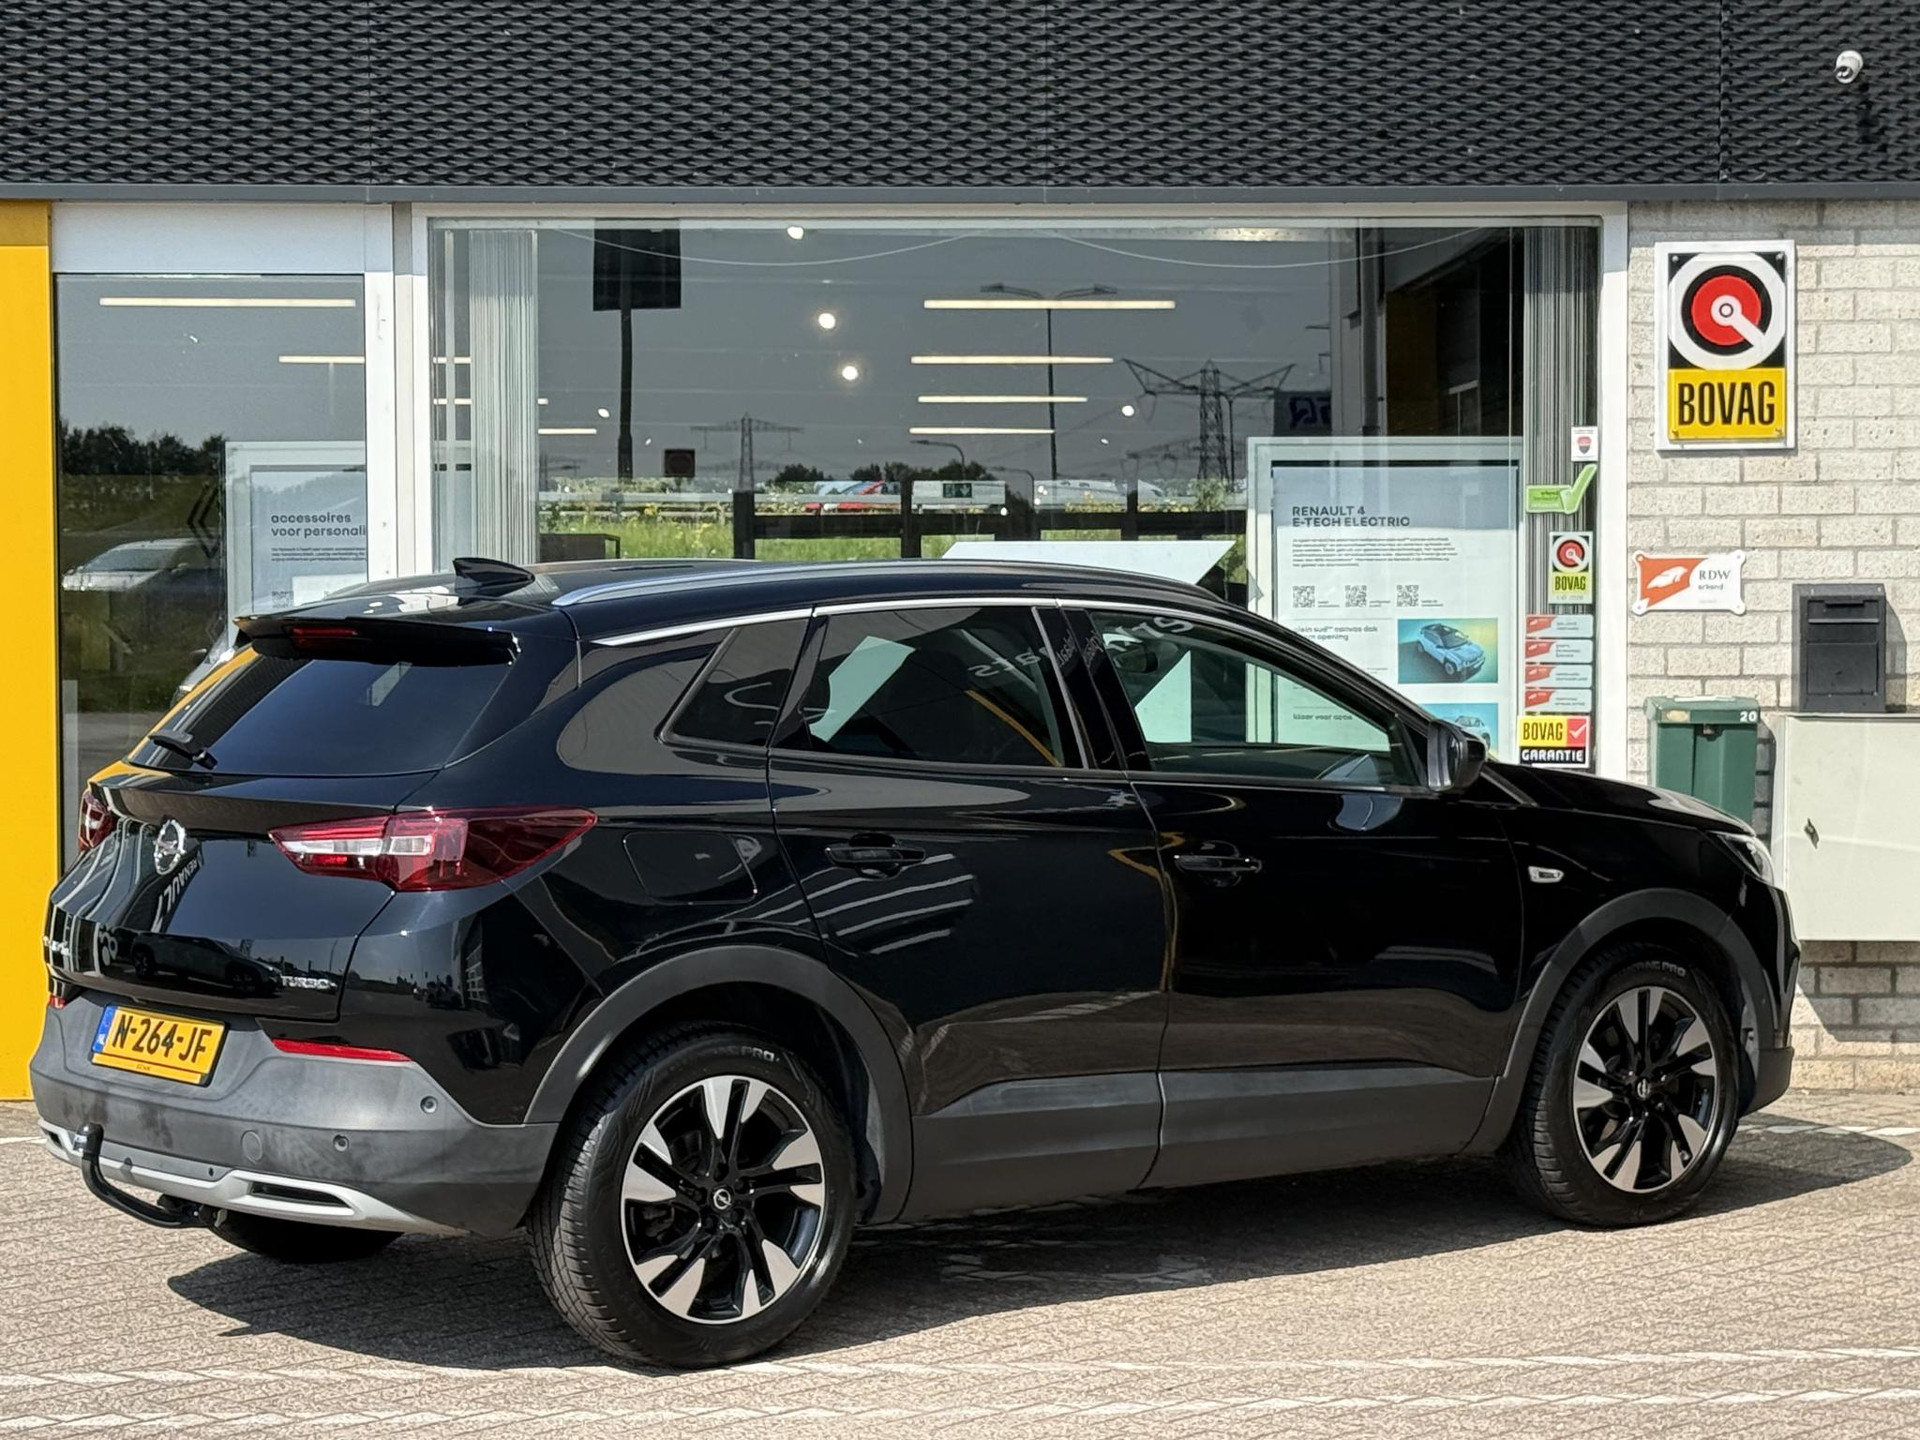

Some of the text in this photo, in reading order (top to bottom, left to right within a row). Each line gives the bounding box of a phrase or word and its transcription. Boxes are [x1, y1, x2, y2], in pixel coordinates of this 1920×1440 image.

[1678, 381, 1775, 426] BOVAG
[271, 512, 352, 523] accessoires
[1292, 506, 1366, 516] RENAULT 4
[1292, 516, 1411, 527] E-TECH ELECTRIC
[271, 524, 366, 539] voor personali
[1699, 569, 1732, 581] RDW
[1555, 575, 1587, 591] BOVAG
[1740, 710, 1758, 723] 20
[1523, 722, 1563, 741] BOVAG
[1521, 749, 1584, 762] GARANTIE
[281, 975, 331, 990] TURBO
[112, 1014, 213, 1064] N-264-JF
